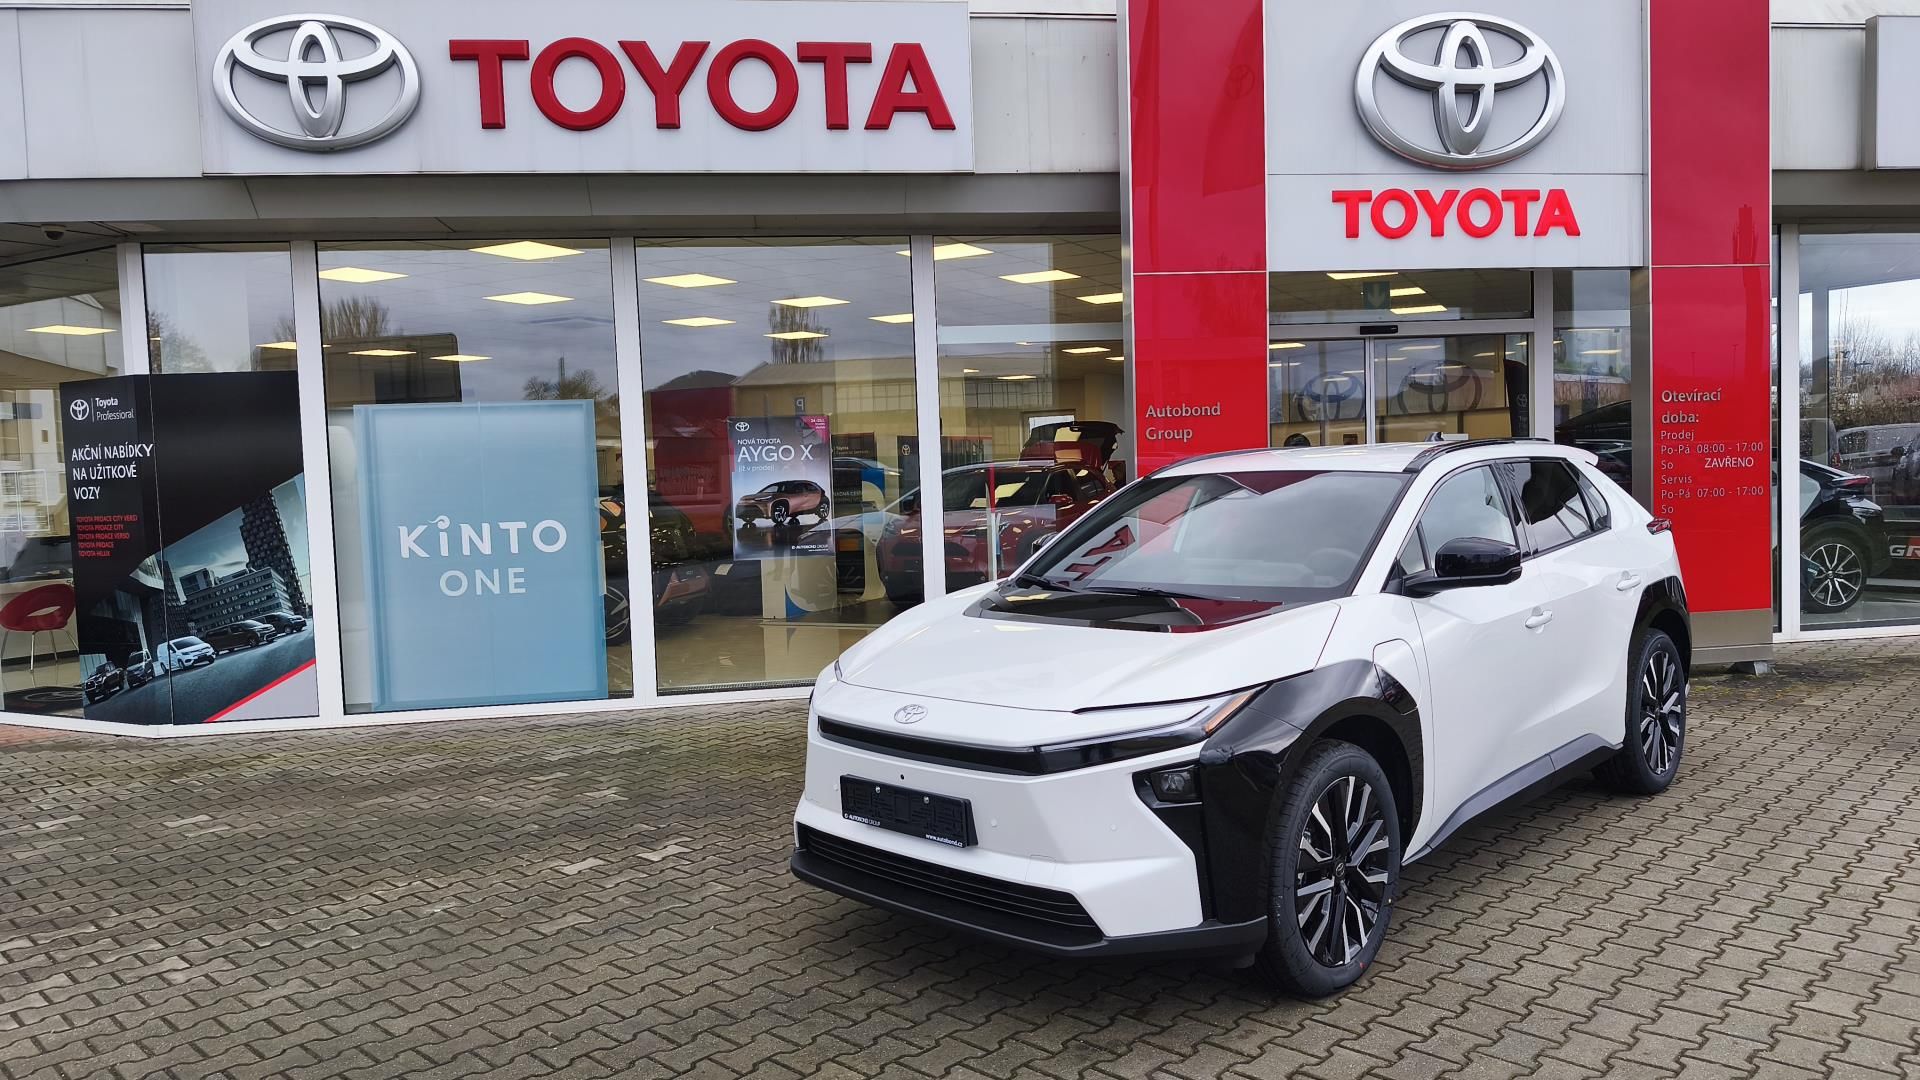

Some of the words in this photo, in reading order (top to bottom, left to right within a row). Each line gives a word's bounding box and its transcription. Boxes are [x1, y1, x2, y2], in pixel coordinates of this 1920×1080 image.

[449, 37, 956, 131] TOYOTA
[1331, 188, 1581, 239] TOYOTA
[1661, 387, 1722, 402] Otevírací
[95, 397, 118, 408] Toyota
[1145, 401, 1221, 418] Autobond
[97, 408, 135, 420] Professional
[1661, 410, 1699, 423] doba:
[1145, 427, 1193, 443] Group
[1660, 430, 1694, 441] Prodej
[71, 443, 102, 461] AKČNÍ
[104, 442, 154, 459] NABÍDKY
[738, 445, 795, 462] AYGO
[800, 444, 814, 461] X
[1661, 444, 1690, 454] Po-Pá
[1696, 443, 1725, 453] 08:00
[1736, 442, 1764, 452] 17:00
[1661, 460, 1674, 470] So
[1704, 456, 1754, 468] ZAVŘENO
[73, 467, 88, 480] NA
[90, 461, 137, 479] UŽITKOVÉ
[1661, 474, 1692, 484] Servis
[73, 486, 101, 499] VOZY
[1661, 488, 1691, 499] Po-Pá
[1697, 487, 1725, 498] 07:00
[1736, 486, 1764, 496] 17:00
[1661, 505, 1674, 514] So
[439, 567, 527, 597] ONE
[925, 833, 963, 847] www.autobond.cz
